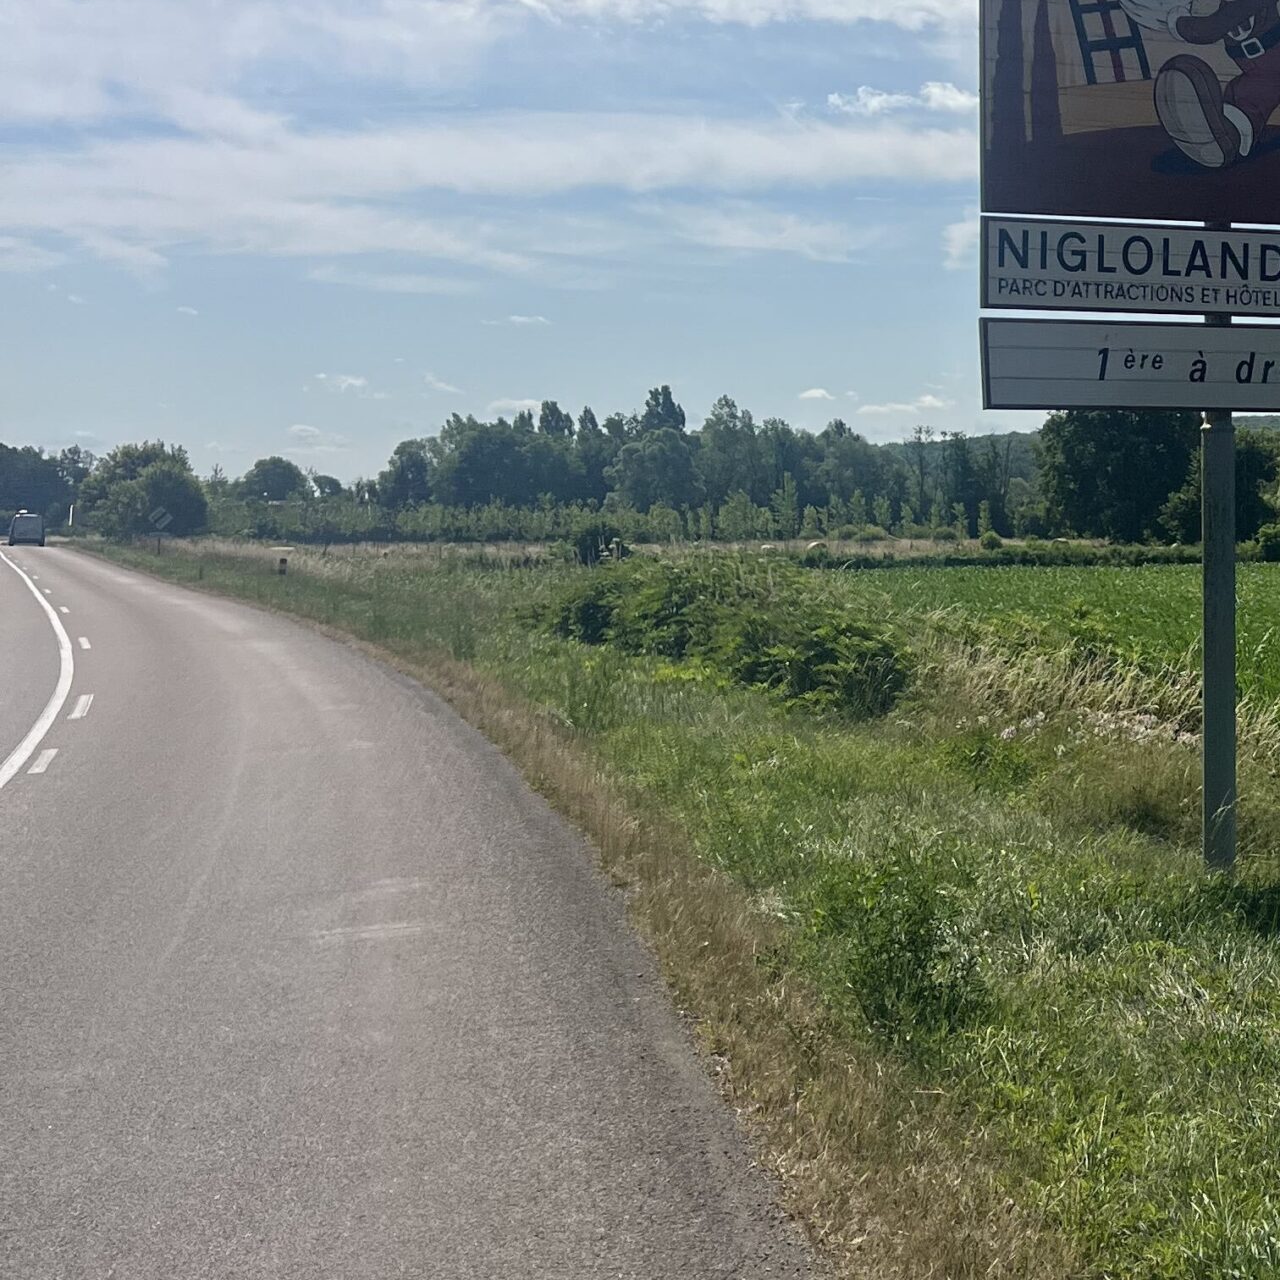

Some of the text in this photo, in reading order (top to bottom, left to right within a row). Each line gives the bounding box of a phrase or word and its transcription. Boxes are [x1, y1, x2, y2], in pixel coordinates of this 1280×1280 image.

[998, 277, 1048, 297] PARC
[1053, 280, 1195, 304] D'ATTRACTIONS
[1201, 287, 1221, 305] ET
[1188, 350, 1208, 383] à
